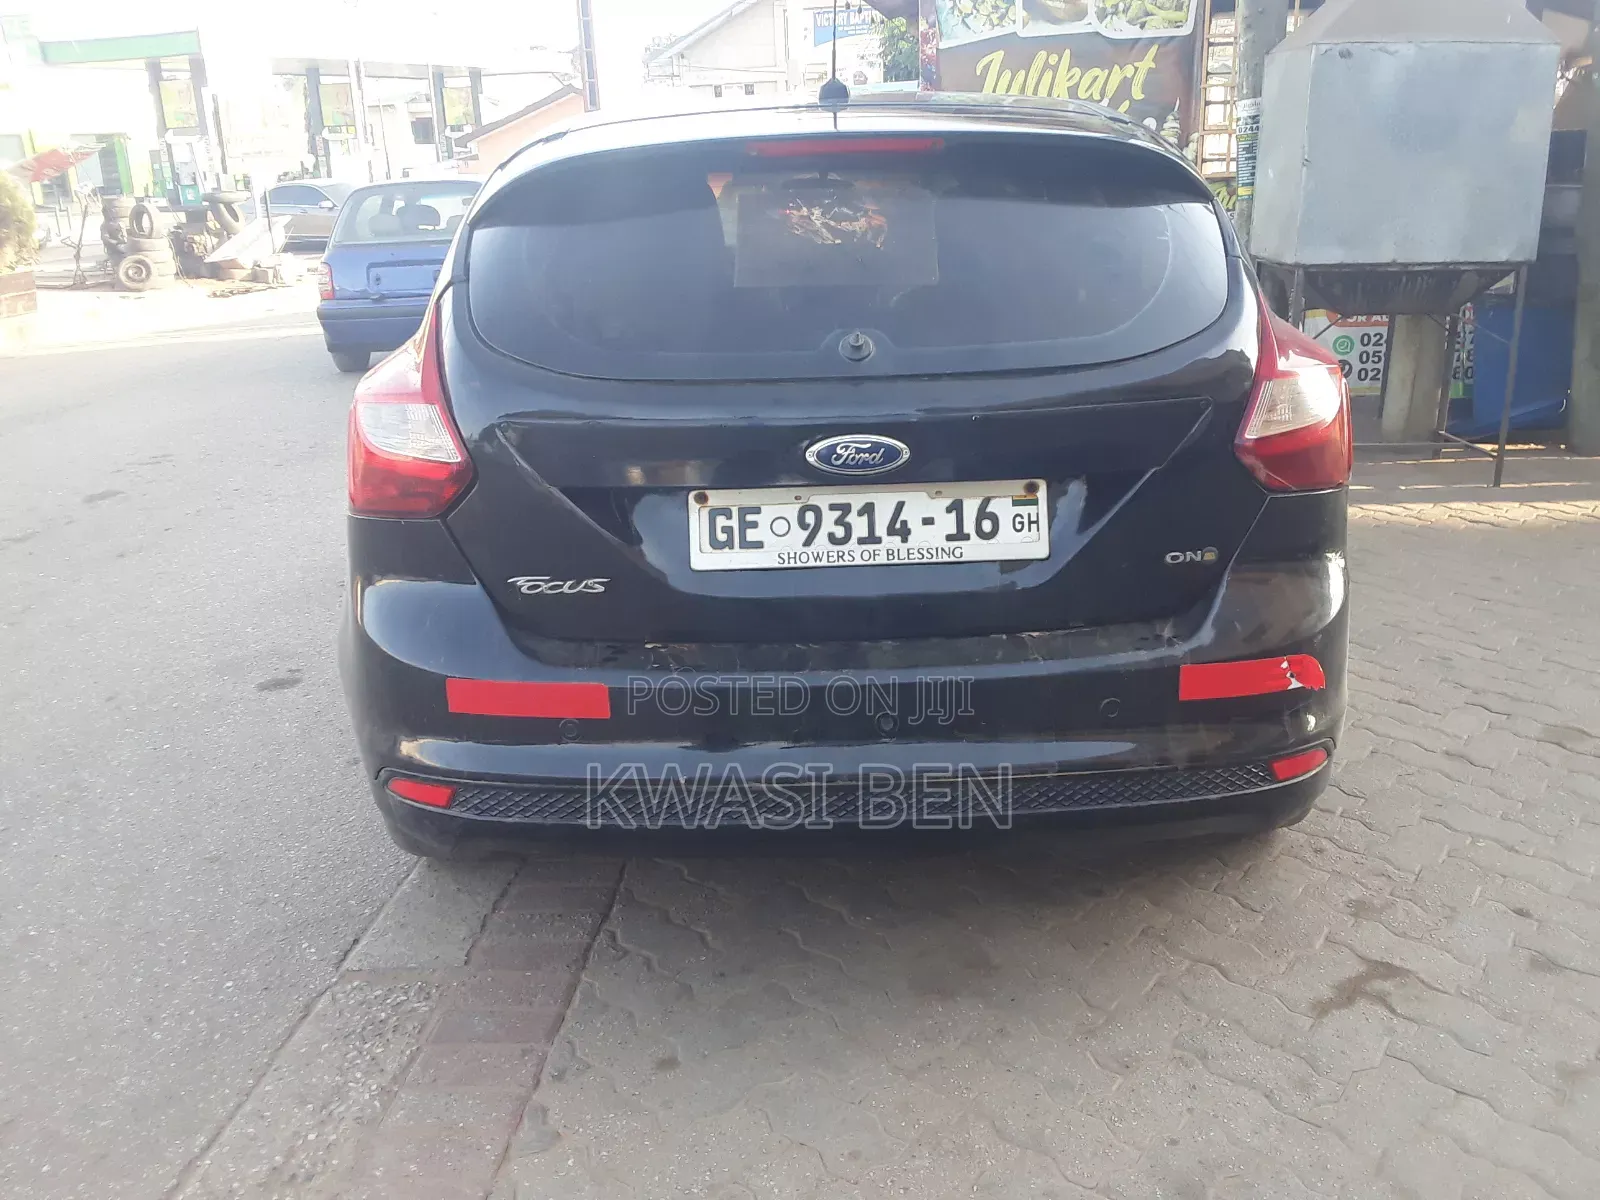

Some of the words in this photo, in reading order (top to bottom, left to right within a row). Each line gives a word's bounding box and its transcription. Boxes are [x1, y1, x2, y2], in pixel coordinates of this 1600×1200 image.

[1360, 332, 1386, 347] 02
[1358, 350, 1386, 365] 05
[831, 442, 884, 467] Ford
[708, 506, 764, 551] GE
[797, 497, 1000, 548] 9314-16
[1012, 511, 1040, 534] GH
[777, 549, 856, 566] SHOWERS
[860, 548, 882, 563] OF
[886, 545, 964, 562] BLESSING
